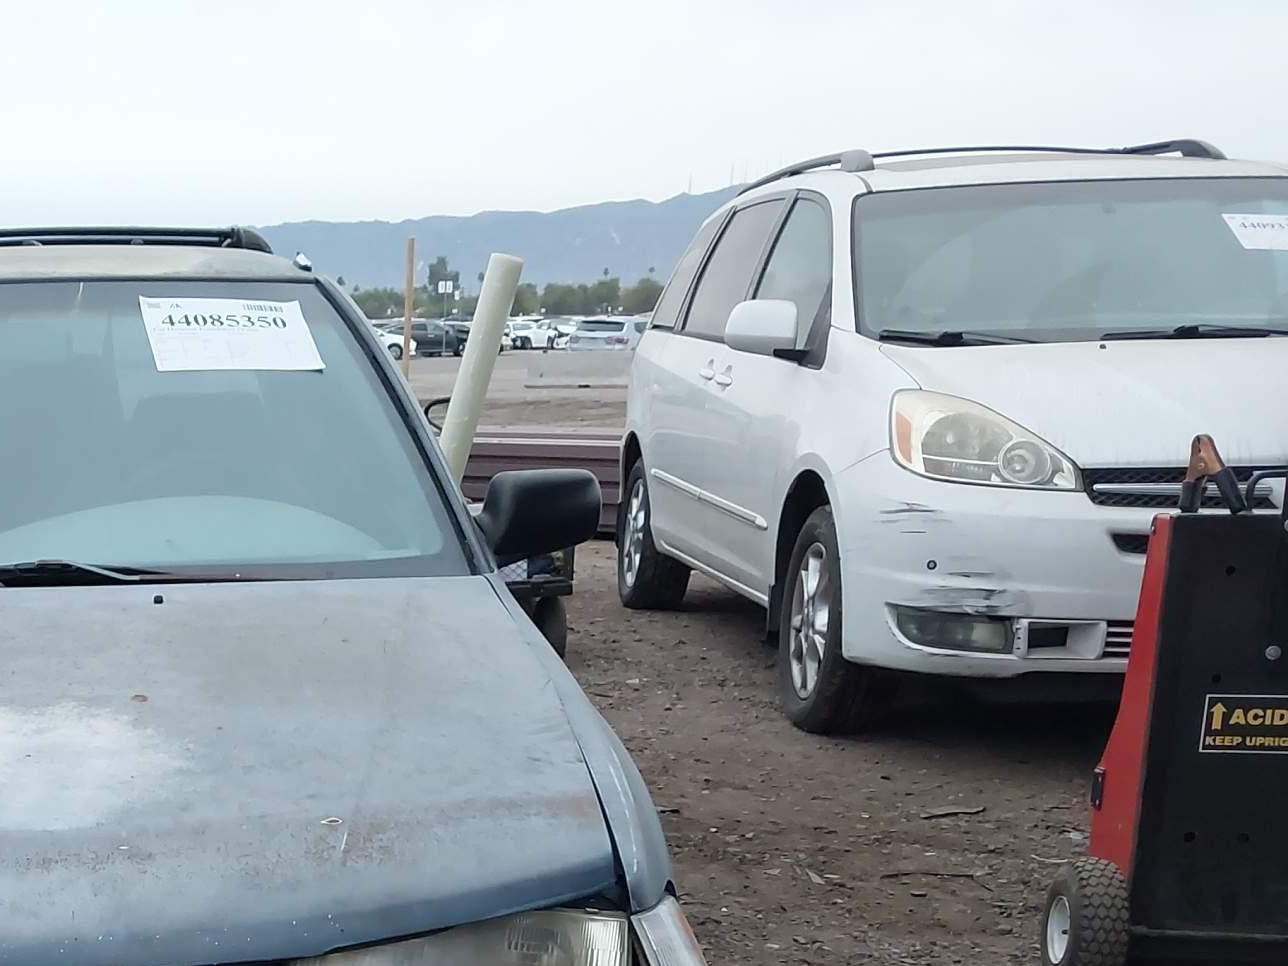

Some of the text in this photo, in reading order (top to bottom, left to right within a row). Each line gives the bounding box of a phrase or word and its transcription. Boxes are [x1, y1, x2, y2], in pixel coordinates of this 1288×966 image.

[161, 313, 287, 329] 44085350
[1229, 708, 1288, 726] ACID
[1204, 735, 1243, 746] KEEP
